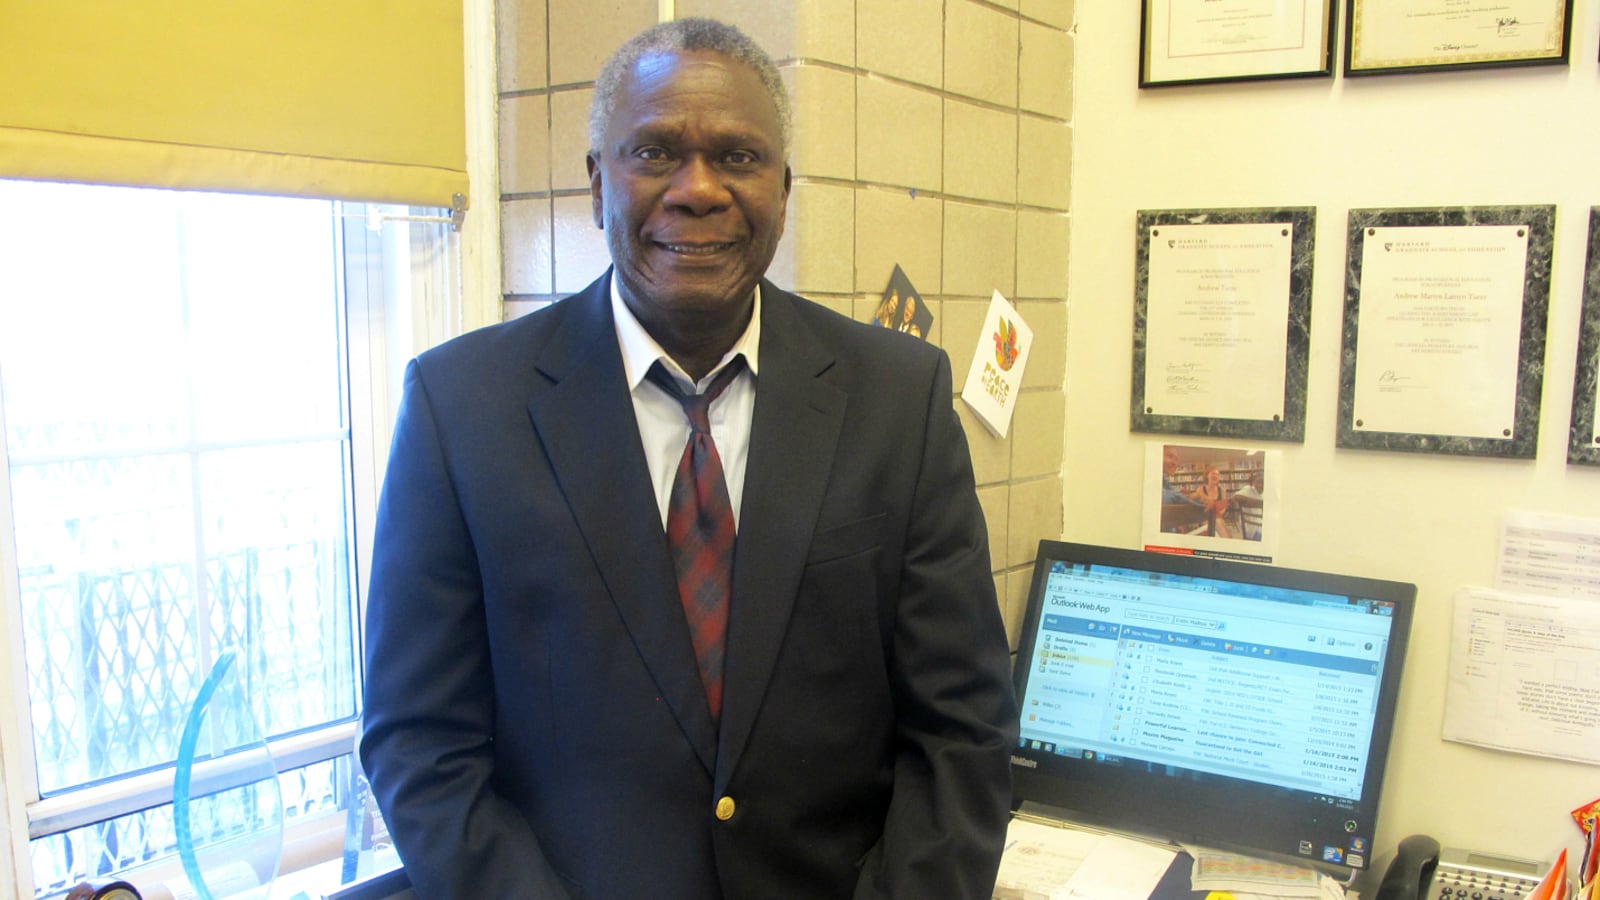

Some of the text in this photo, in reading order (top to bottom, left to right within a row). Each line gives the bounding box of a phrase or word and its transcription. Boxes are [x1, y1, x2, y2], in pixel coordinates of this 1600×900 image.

[1051, 598, 1111, 614] Outlook Web App
[1055, 636, 1073, 644] Deleted
[1145, 720, 1167, 729] Powerful
[1347, 766, 1357, 774] PM
